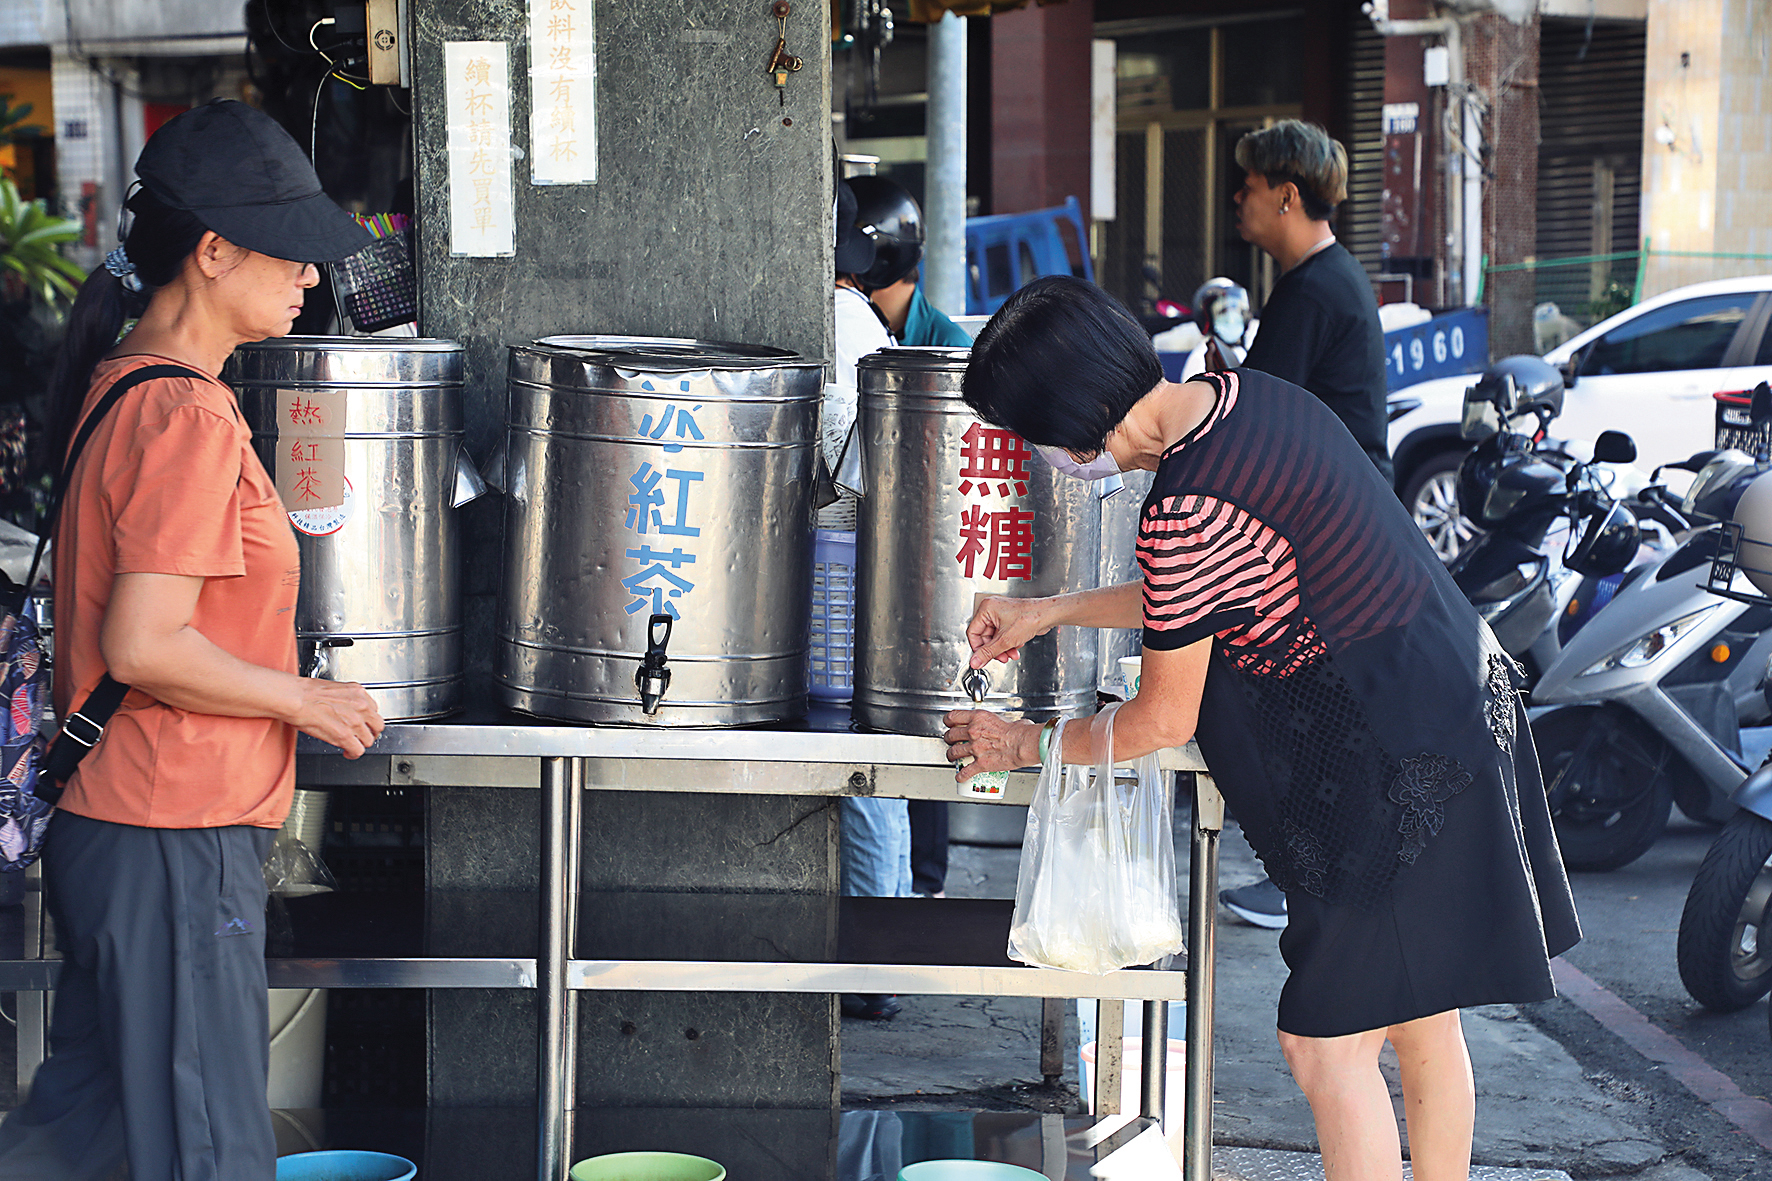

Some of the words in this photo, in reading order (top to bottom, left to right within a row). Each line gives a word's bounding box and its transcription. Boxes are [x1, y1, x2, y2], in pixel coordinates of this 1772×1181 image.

[464, 56, 497, 236] 續杯請先買單
[289, 396, 323, 502] 熱紅茶
[620, 380, 705, 627] 冰紅茶
[955, 422, 1035, 581] 無糖
